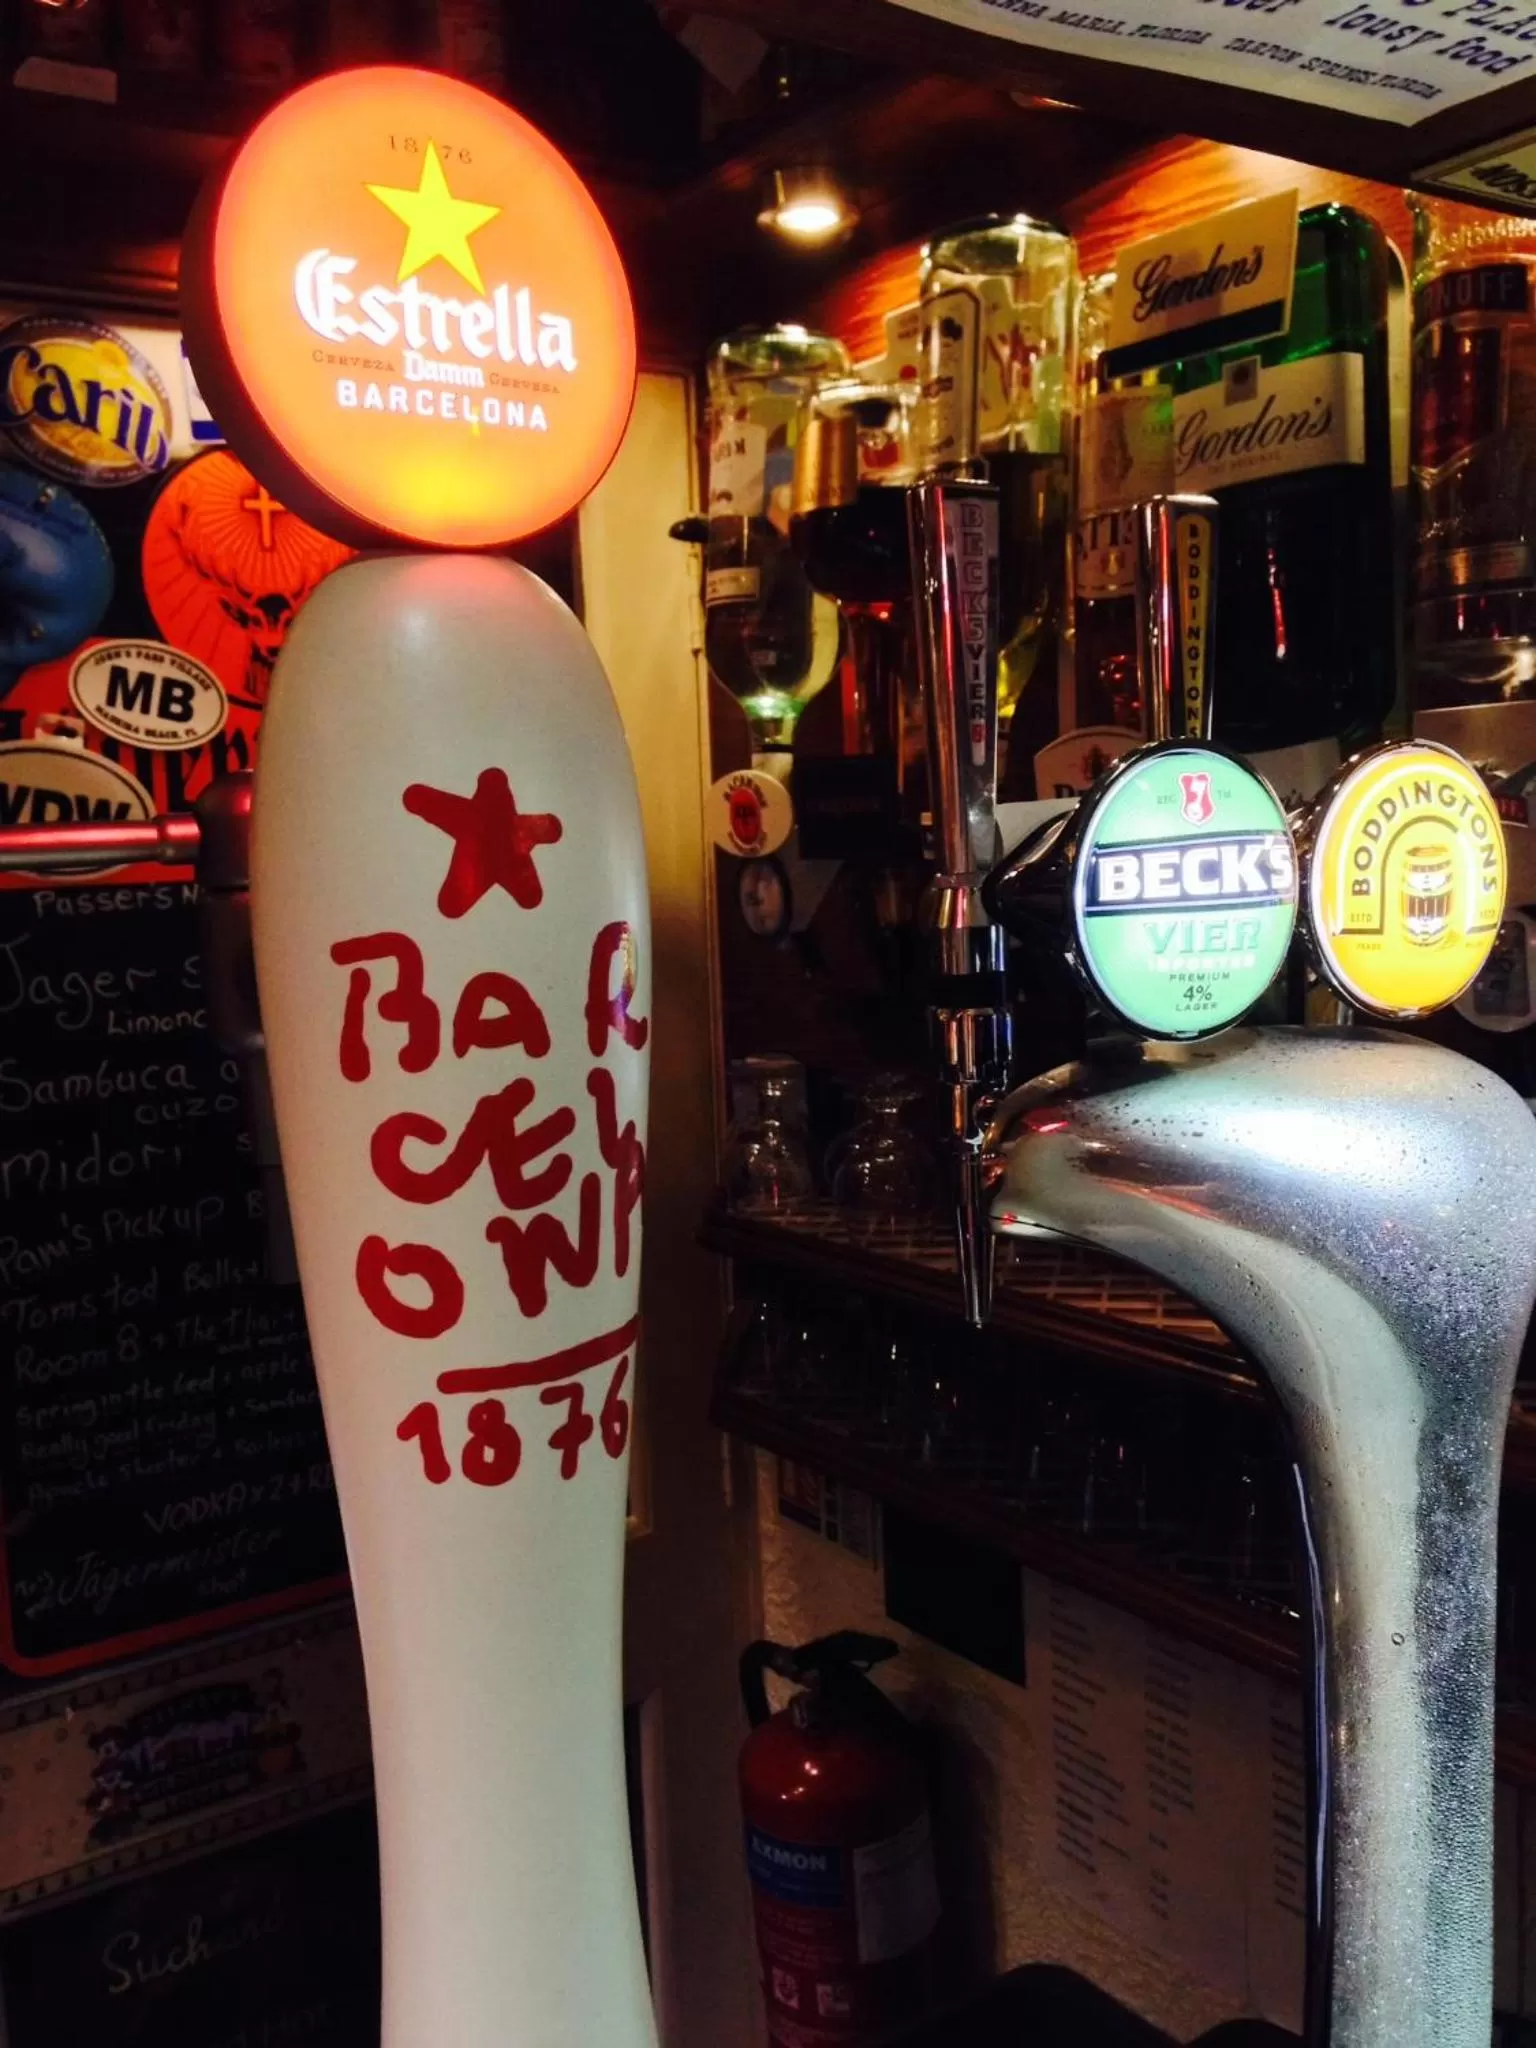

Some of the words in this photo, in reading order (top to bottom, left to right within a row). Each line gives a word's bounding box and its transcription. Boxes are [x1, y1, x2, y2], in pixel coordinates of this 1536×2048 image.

[1223, 37, 1303, 63] TARPON
[1323, 3, 1446, 54] lousy
[1433, 36, 1534, 74] food
[294, 247, 577, 373] Estrella
[1132, 244, 1264, 322] Gordon's
[403, 348, 485, 388] Damm
[0, 345, 167, 474] Carib
[336, 379, 548, 432] BARCELONA
[1175, 394, 1333, 476] Gordon's
[106, 664, 197, 722] MB
[1098, 835, 1293, 901] BECK'S
[1351, 780, 1498, 896] BODDINGTONS
[1144, 917, 1262, 953] VIER
[330, 920, 649, 1083] BAR
[1169, 972, 1230, 982] PREMIUM
[1175, 1002, 1218, 1013] LAGER
[1183, 985, 1213, 1001] 4%
[369, 1066, 645, 1211] CEL
[396, 1355, 630, 1487] 1876
